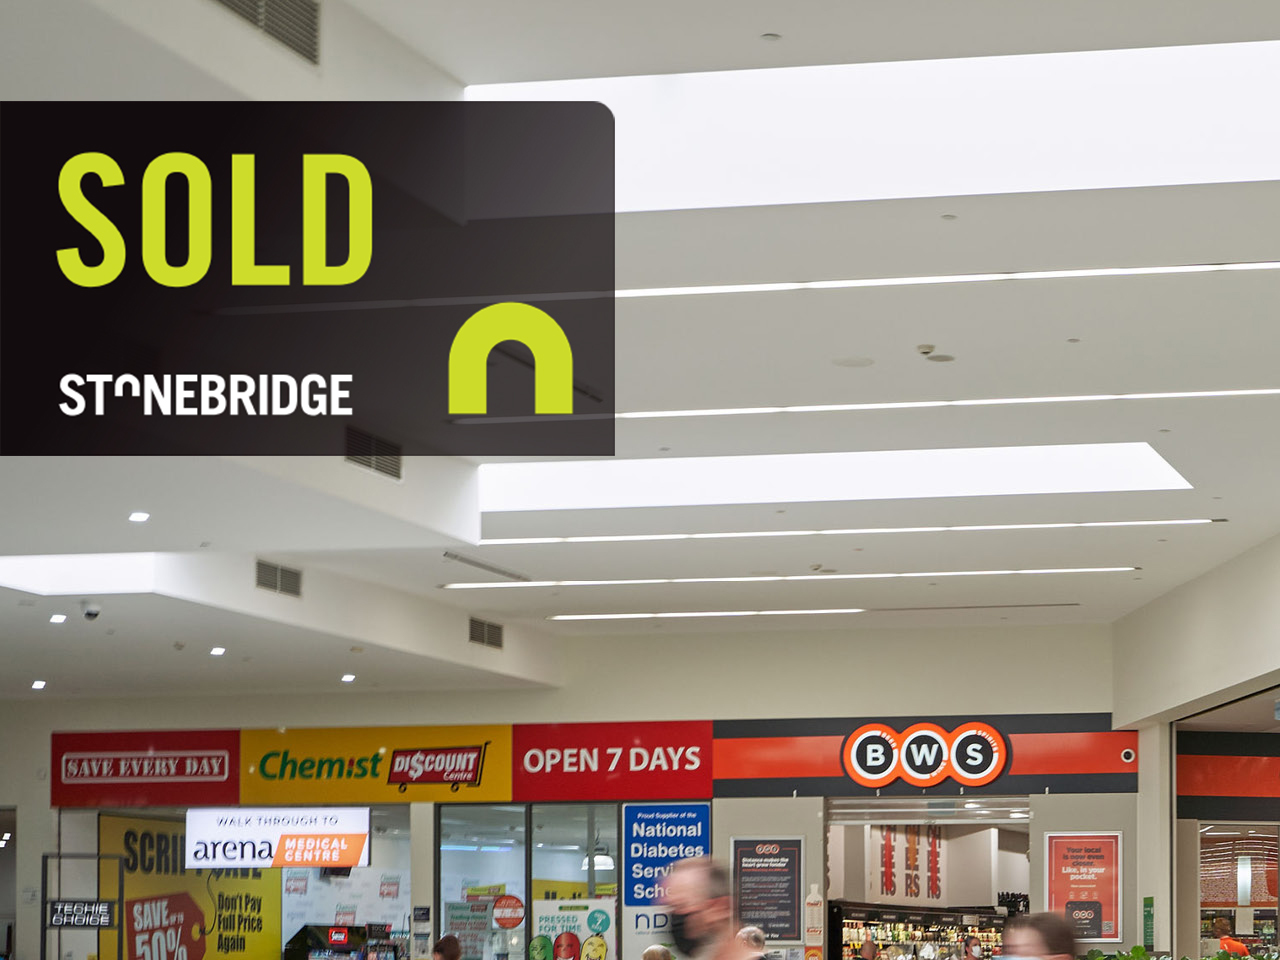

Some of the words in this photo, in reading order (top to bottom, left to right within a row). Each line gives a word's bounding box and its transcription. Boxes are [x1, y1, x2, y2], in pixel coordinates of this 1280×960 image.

[881, 732, 897, 748] BEER
[977, 730, 999, 752] SPIRITS
[523, 748, 598, 773] OPEN
[606, 747, 623, 772] 7
[629, 746, 700, 772] DAYS
[866, 743, 984, 767] BWS
[67, 759, 114, 777] SAVE
[119, 758, 178, 776] EVERY
[185, 757, 223, 776] DAY
[259, 750, 383, 780] Chemist
[443, 771, 473, 781] Centre
[216, 815, 252, 827] WALK
[257, 815, 318, 826] THROUGH
[323, 815, 339, 826] TO
[632, 821, 702, 838] National
[193, 839, 274, 861] arena
[284, 837, 348, 850] MEDICAL
[630, 842, 704, 858] Diabetes
[284, 850, 340, 862] CENTRE
[632, 863, 674, 878] Servi
[54, 903, 109, 915] TECHIE
[218, 892, 243, 913] Don't
[245, 894, 262, 914] Pay
[52, 914, 110, 926] CHOICE
[133, 899, 169, 931] SAVE
[218, 914, 235, 930] Full
[238, 912, 263, 933] Price
[538, 915, 578, 923] PRESSED
[538, 924, 557, 933] FOR
[560, 924, 582, 933] TIME
[217, 935, 246, 954] Again
